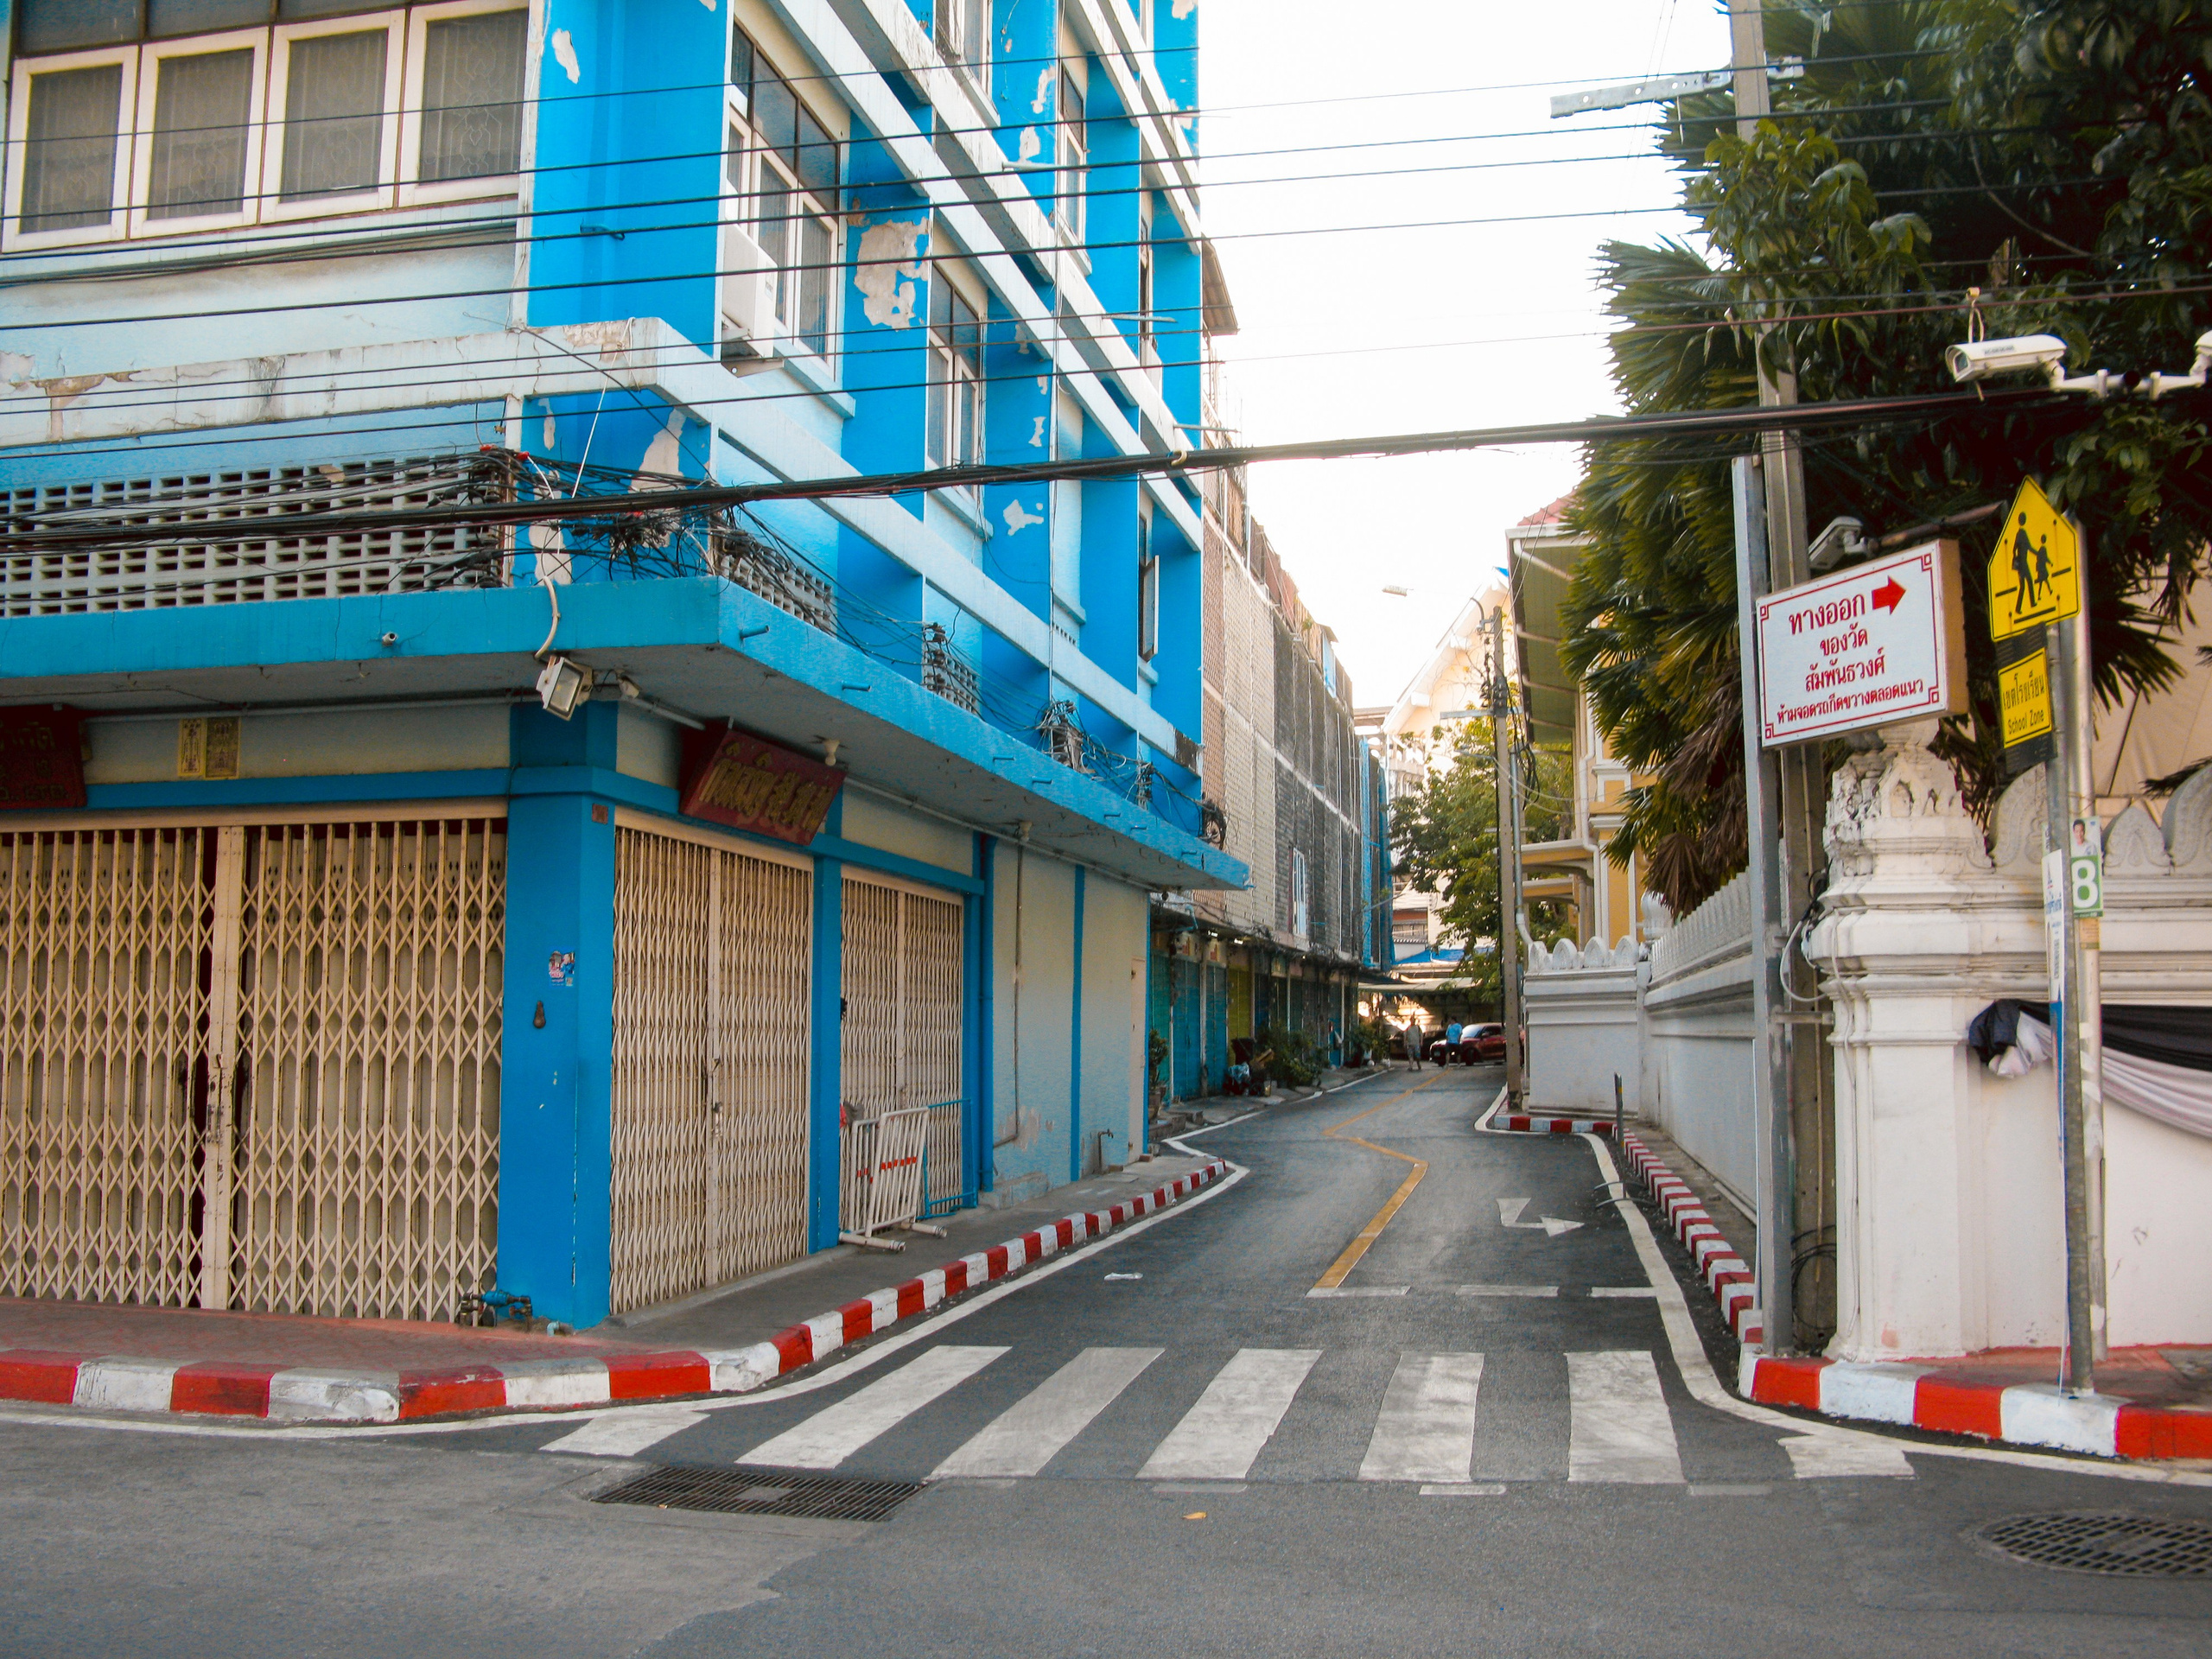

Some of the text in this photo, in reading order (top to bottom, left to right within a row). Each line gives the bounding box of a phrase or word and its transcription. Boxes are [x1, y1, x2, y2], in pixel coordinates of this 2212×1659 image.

[1789, 593, 1866, 636] ทางออก
[1820, 621, 1868, 657] ของวัด
[1805, 646, 1885, 692] สัมพันธวงศ์
[1777, 677, 1924, 725] ห้ามจอดรถกีดขวางตลอดแนว
[2007, 709, 2044, 734] School Zone
[2072, 859, 2099, 909] 8
